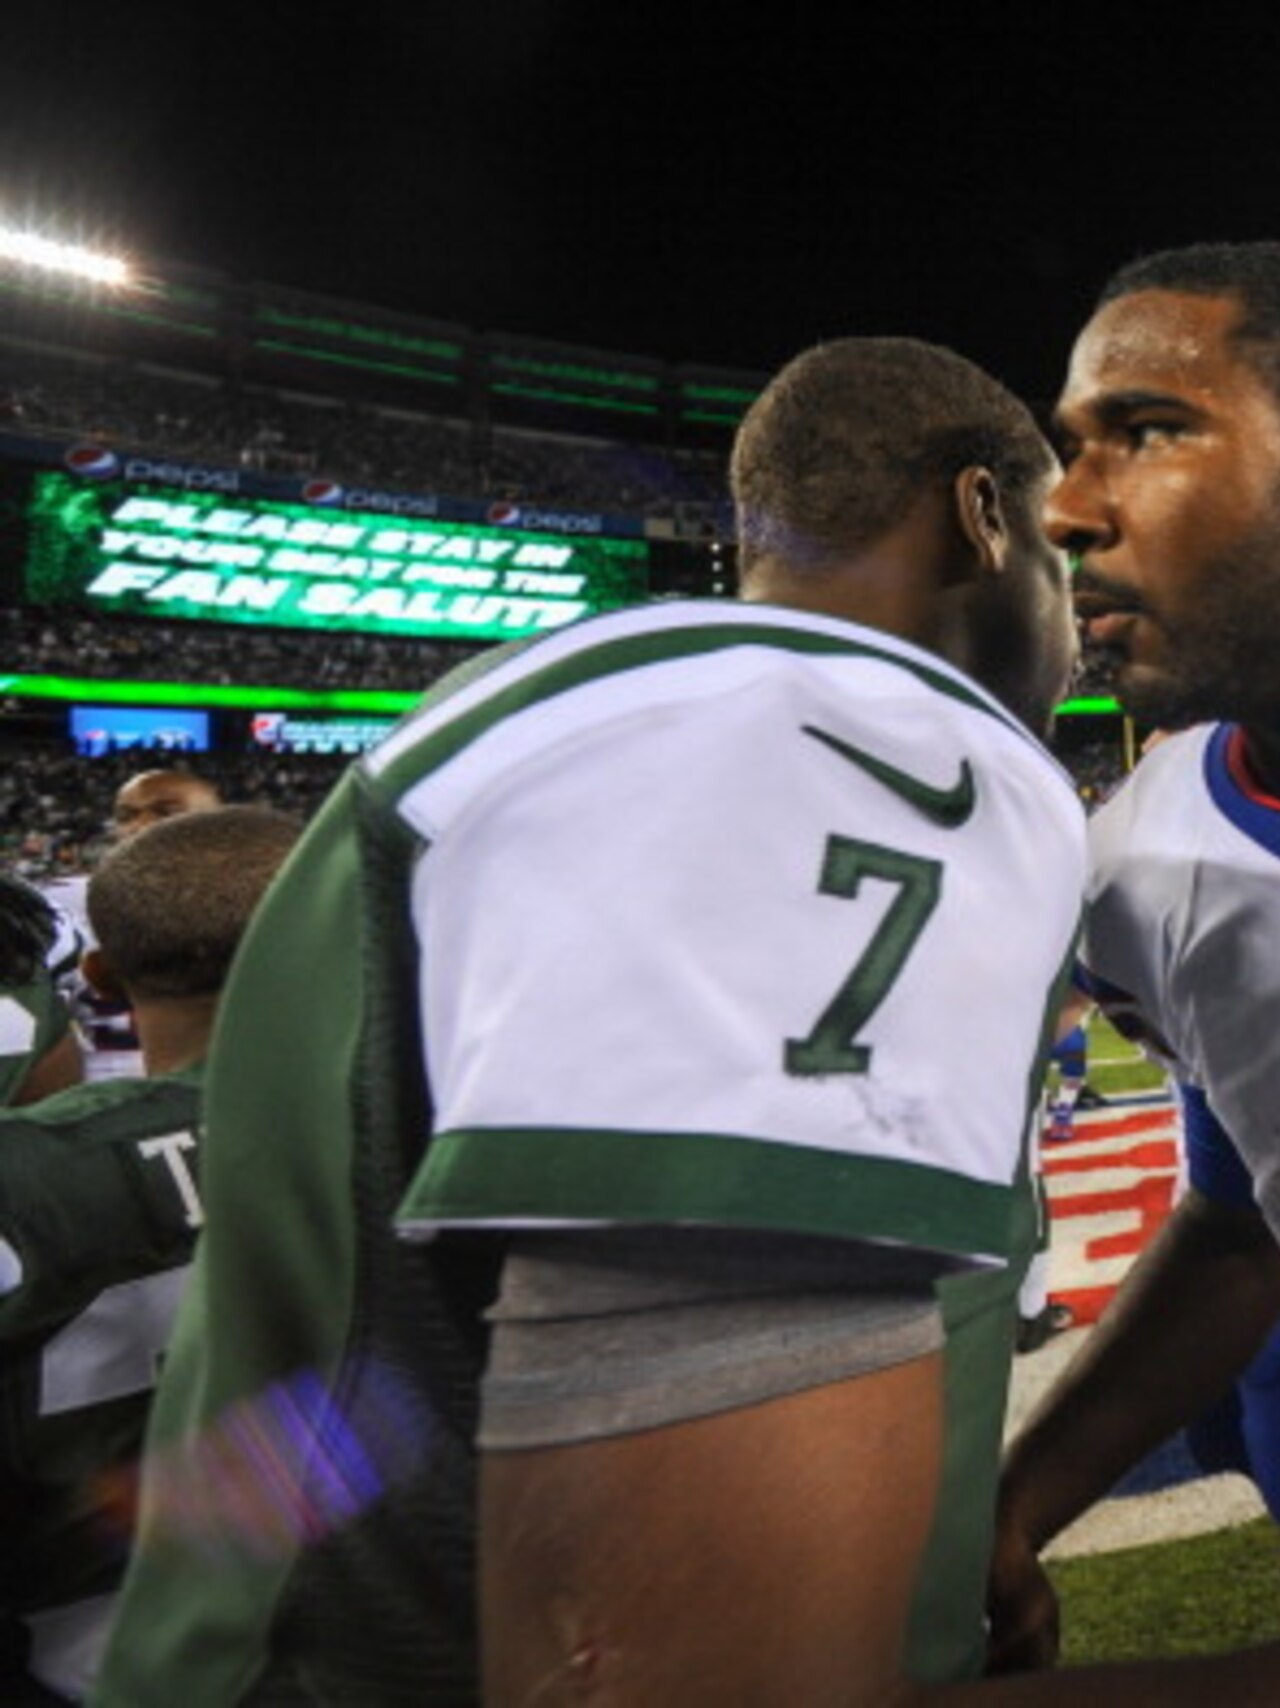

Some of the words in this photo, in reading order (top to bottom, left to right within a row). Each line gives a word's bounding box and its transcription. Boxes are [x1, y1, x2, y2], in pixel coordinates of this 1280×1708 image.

[125, 460, 240, 492] pepsi
[345, 489, 438, 516] pepsi
[110, 496, 365, 549] PLEASE
[367, 529, 516, 563] STAY
[510, 541, 575, 569] IN
[522, 513, 602, 534] pepsi
[100, 528, 267, 569] YOUR
[85, 562, 293, 611] FAN
[782, 830, 945, 1080] 7
